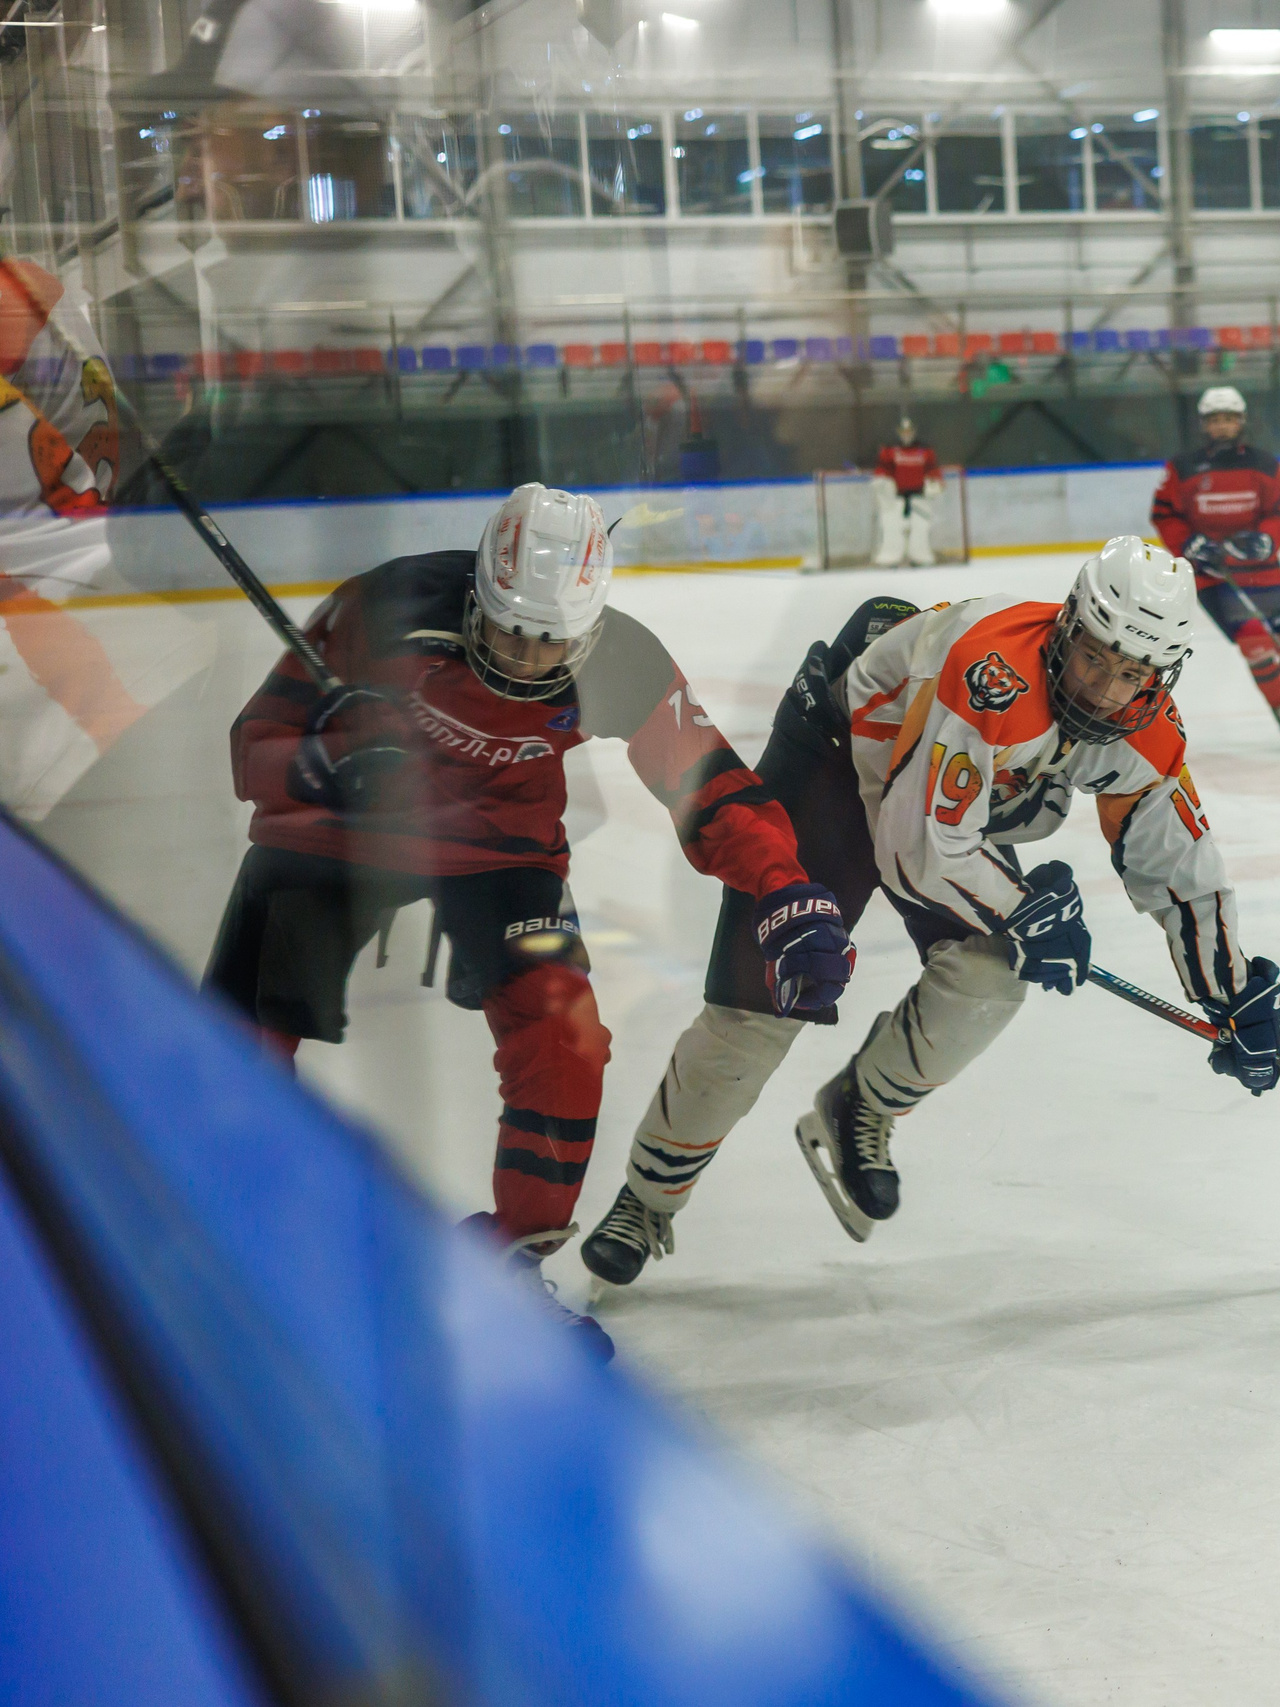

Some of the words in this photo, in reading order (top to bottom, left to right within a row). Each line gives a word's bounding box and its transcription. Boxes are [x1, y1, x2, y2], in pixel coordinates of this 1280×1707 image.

[873, 602, 916, 613] VAPOR
[1125, 624, 1160, 642] CCM
[925, 742, 983, 826] 19
